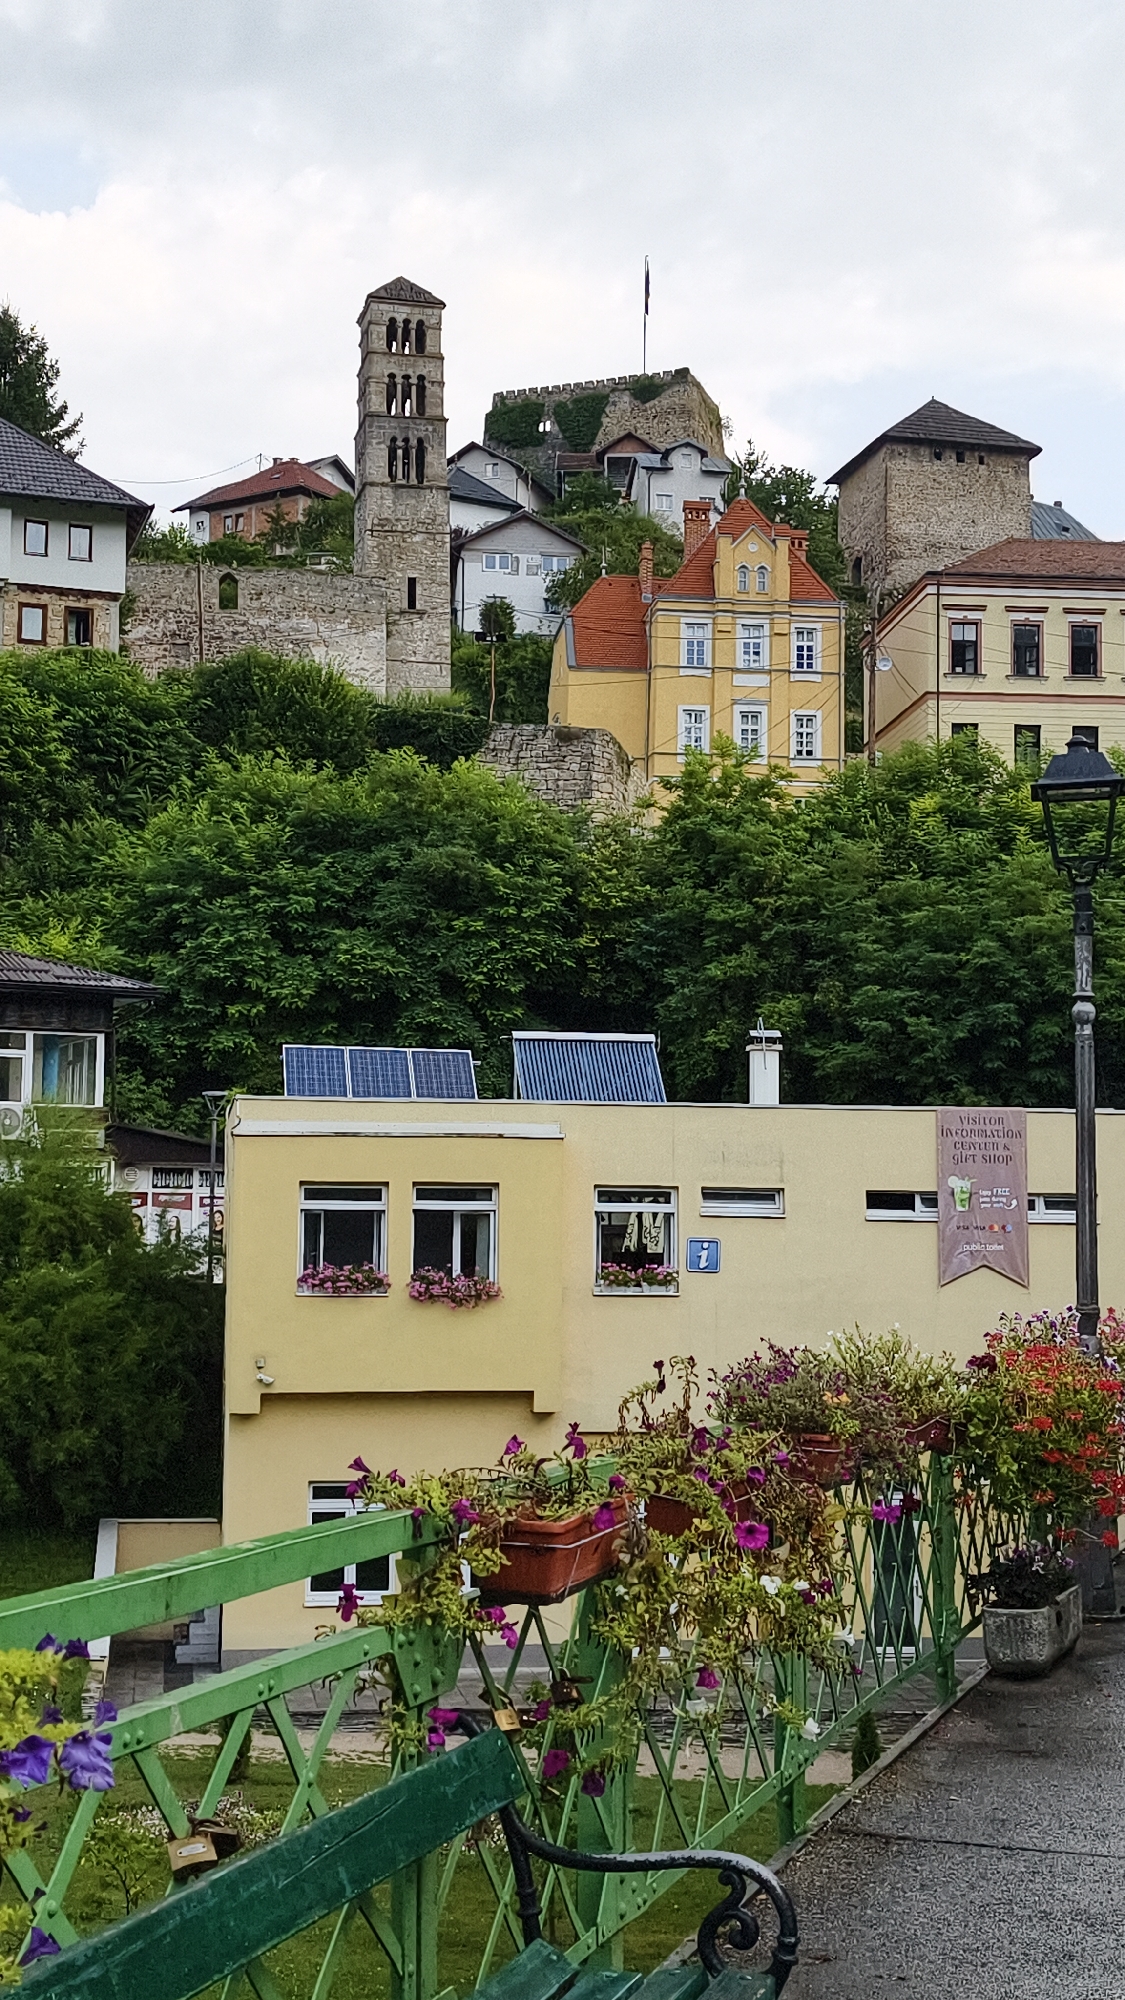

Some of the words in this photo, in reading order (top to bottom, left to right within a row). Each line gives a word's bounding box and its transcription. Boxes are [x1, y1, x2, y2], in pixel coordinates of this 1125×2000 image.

[981, 1153, 1012, 1166] SHOP
[993, 1187, 1010, 1196] FREE
[963, 1243, 985, 1251] public
